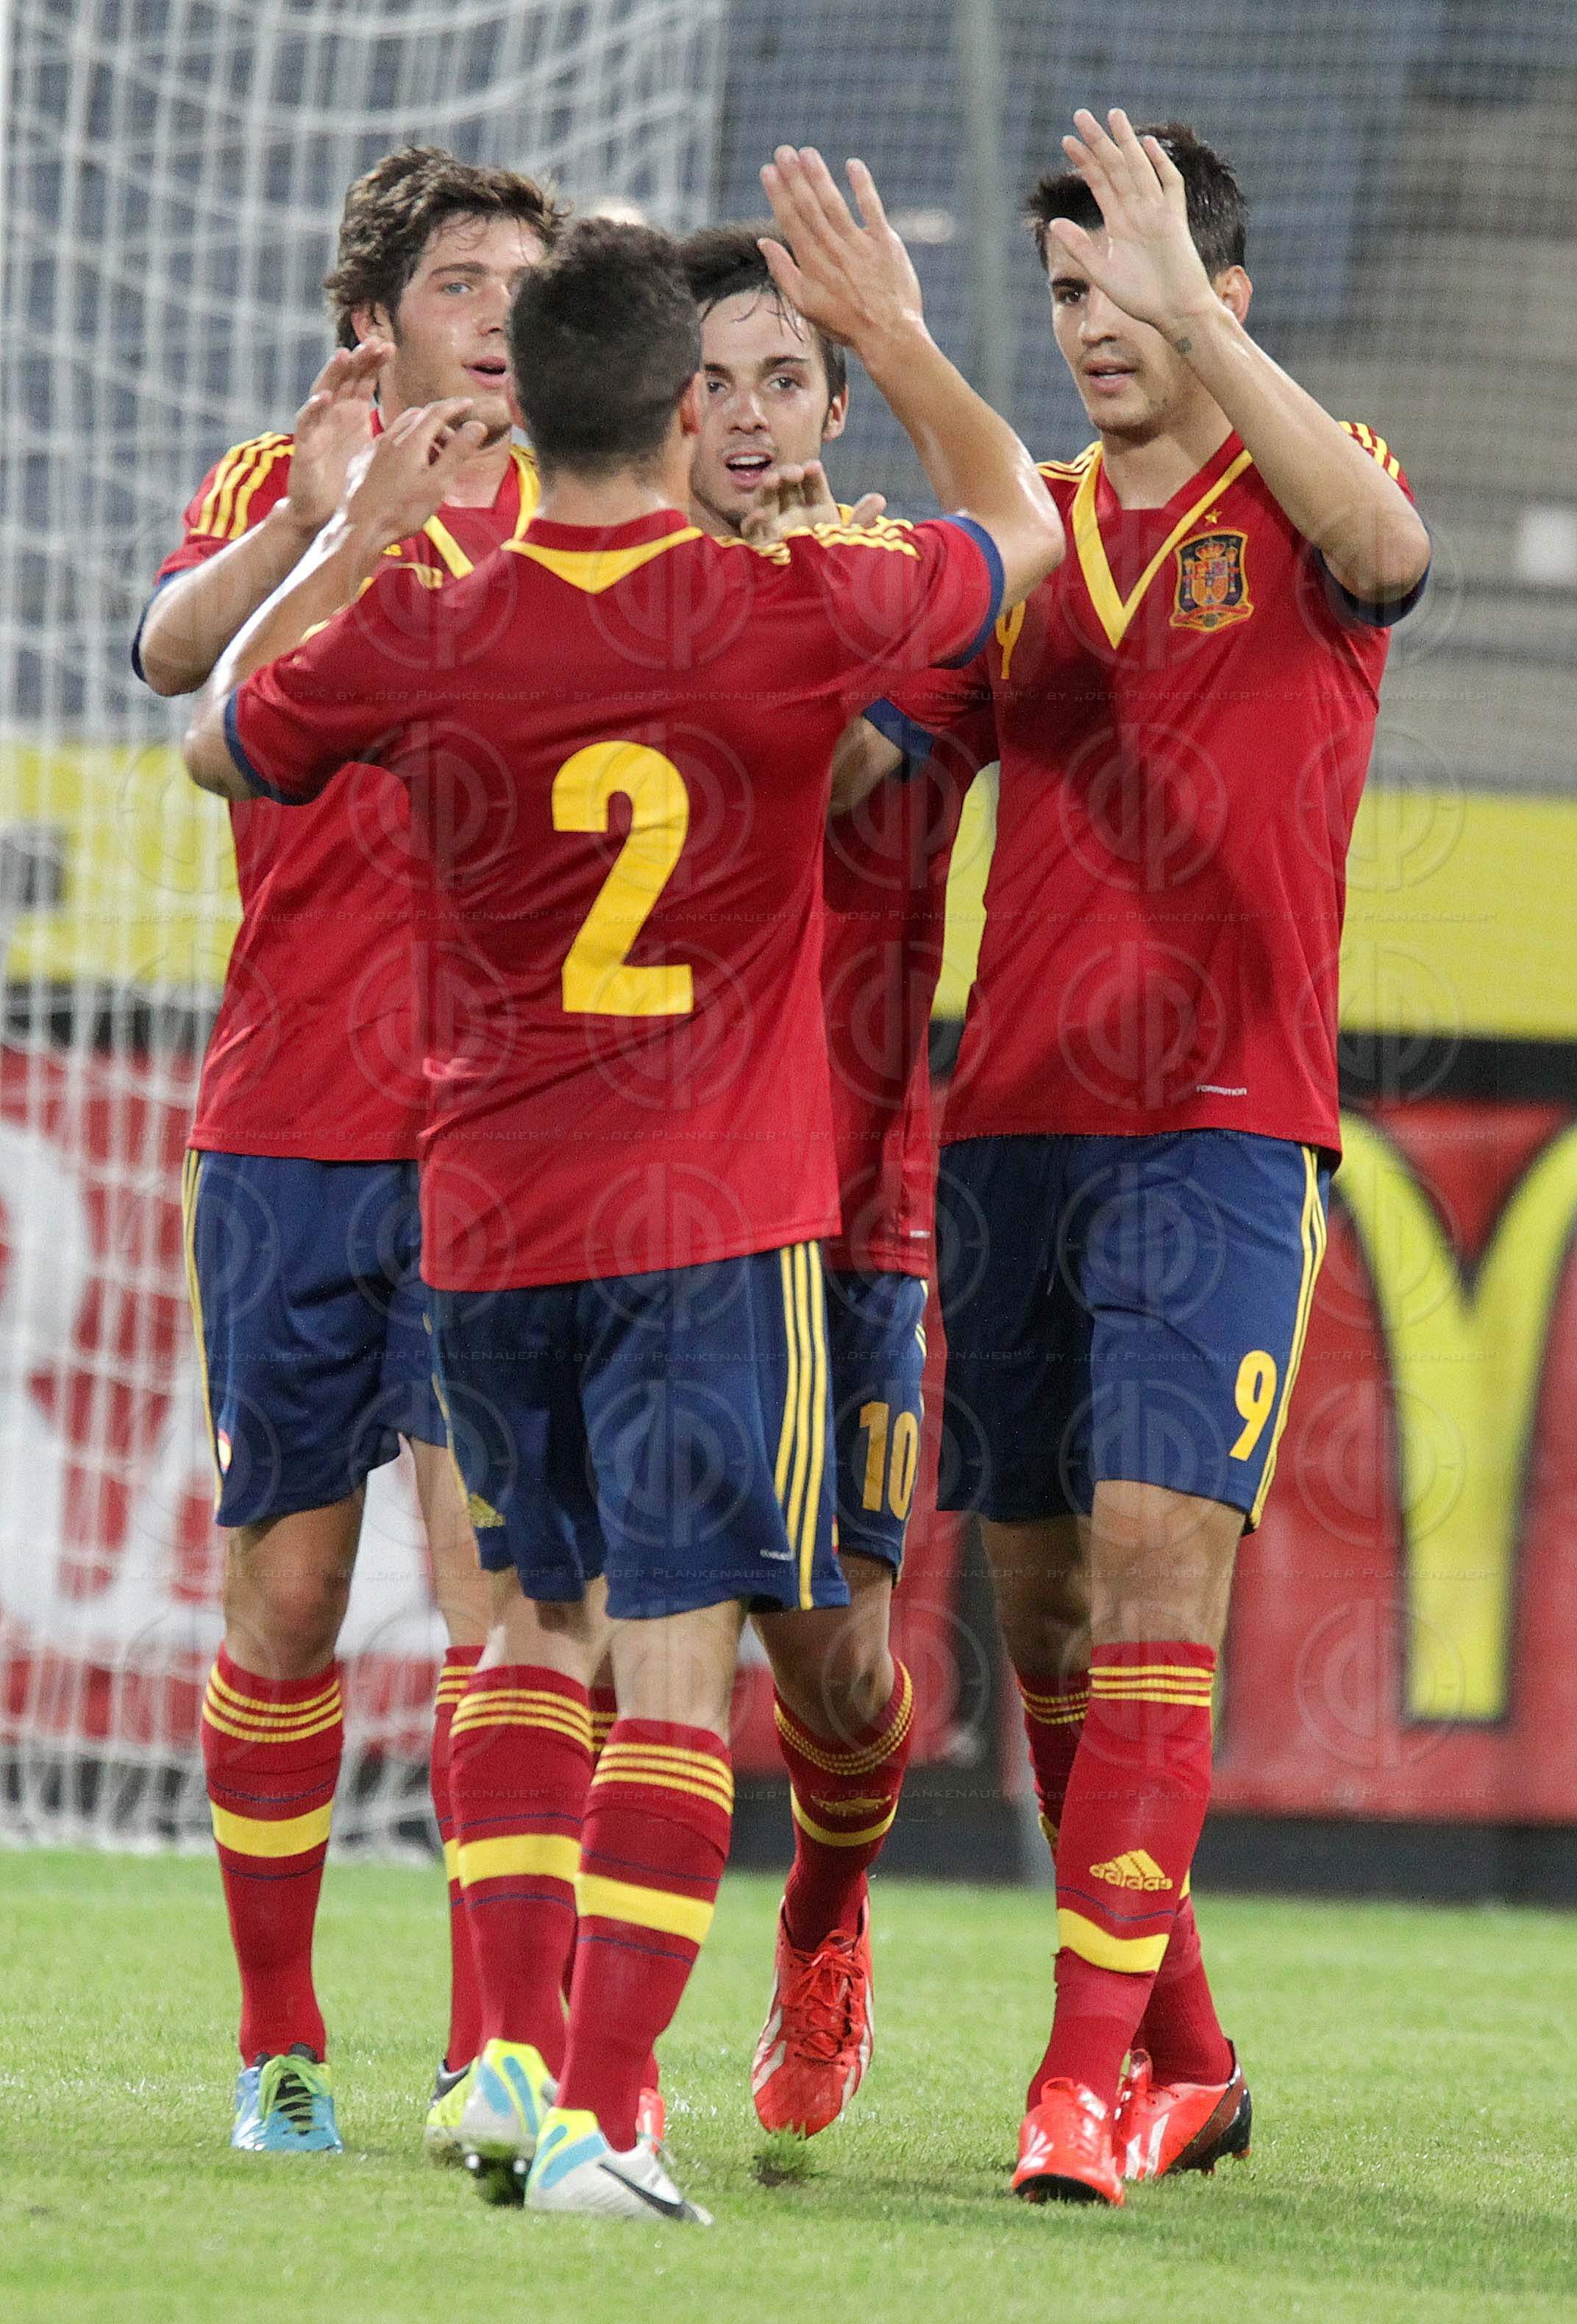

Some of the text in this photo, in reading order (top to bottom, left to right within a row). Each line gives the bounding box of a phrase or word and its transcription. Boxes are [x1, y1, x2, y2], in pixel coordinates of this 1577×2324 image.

[552, 740, 694, 1017] 2
[860, 1401, 919, 1520] 10
[1229, 1350, 1277, 1461] 9
[1089, 1863, 1173, 1892] adidas
